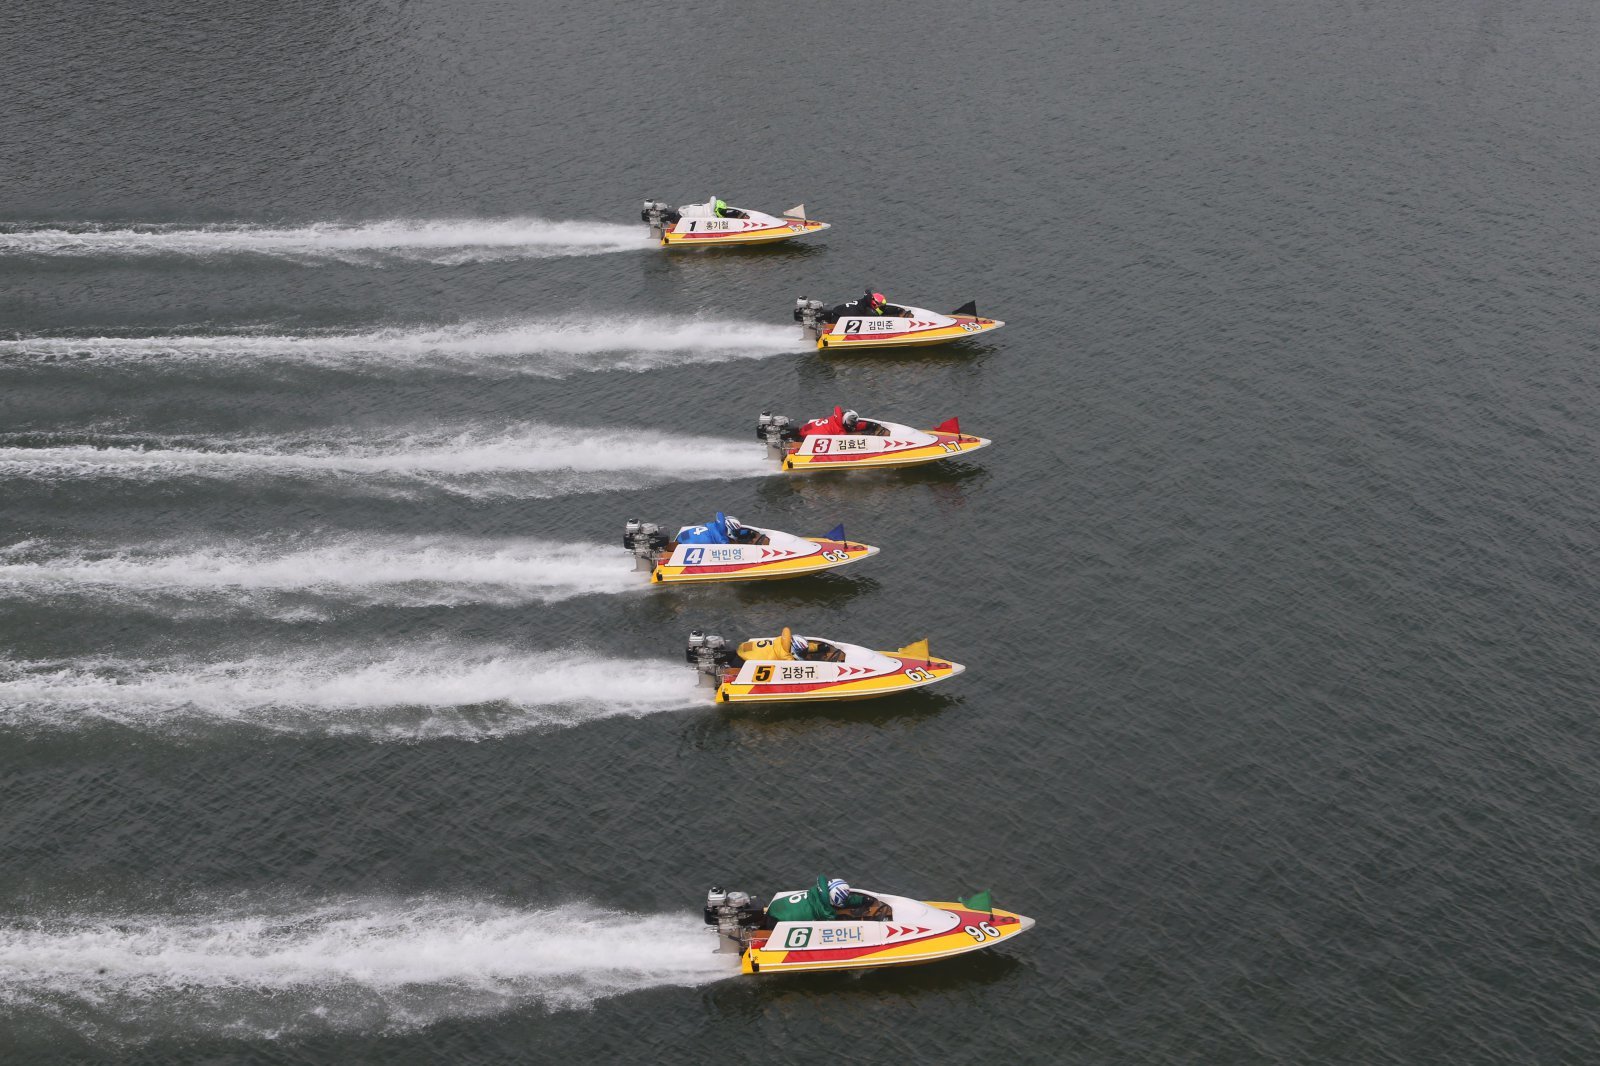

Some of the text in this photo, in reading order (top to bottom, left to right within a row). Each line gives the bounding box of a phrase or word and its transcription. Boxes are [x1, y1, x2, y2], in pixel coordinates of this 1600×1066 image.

[690, 221, 697, 232] 1
[846, 320, 894, 333] 2 김민준
[814, 438, 866, 453] 3 김효년
[938, 440, 962, 453] 17
[693, 526, 709, 536] 4
[686, 547, 742, 564] 4 박민영
[822, 549, 849, 562] 68
[755, 665, 816, 682] 5 김창규
[904, 665, 937, 682] 61
[788, 926, 863, 947] 6 문안나
[963, 921, 1001, 942] 96
